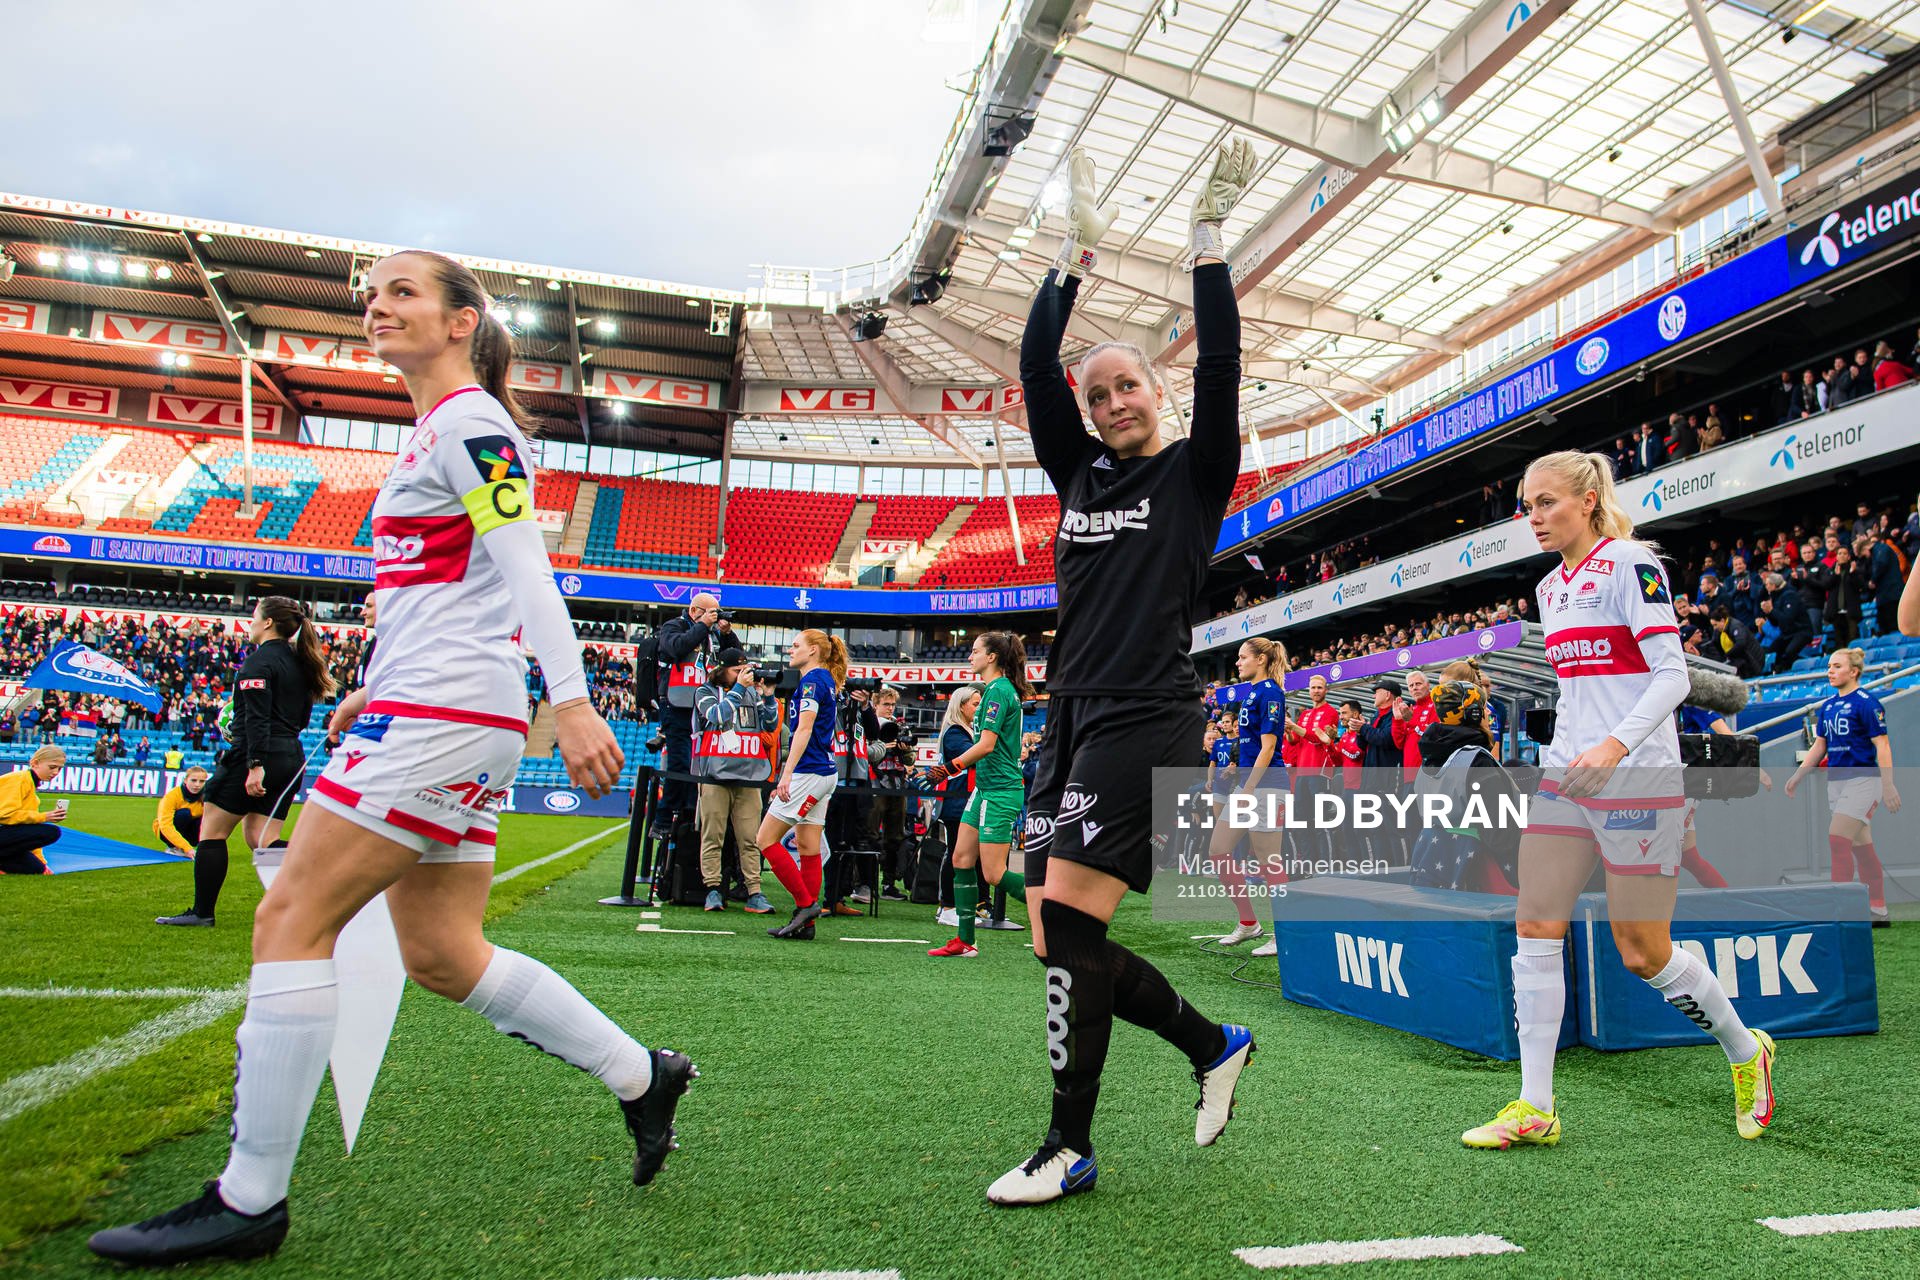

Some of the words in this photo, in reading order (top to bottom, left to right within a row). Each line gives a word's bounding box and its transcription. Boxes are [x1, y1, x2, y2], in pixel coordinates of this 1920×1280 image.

[107, 313, 224, 350] VG
[610, 374, 704, 404] VG
[782, 388, 870, 410] VG
[1497, 359, 1559, 419] FOTBALL
[161, 397, 271, 429] VG
[1796, 423, 1865, 461] telenor
[1662, 471, 1716, 501] telenor
[492, 483, 522, 519] C
[108, 539, 202, 566] SANDVIKEN
[205, 547, 310, 574] TOPPFOTBALL
[1472, 537, 1508, 560] telenor
[1401, 561, 1432, 582] telenor
[1342, 580, 1368, 599] telenor
[1291, 598, 1314, 615] telenor
[240, 680, 265, 690] VG
[873, 668, 921, 681] VG
[929, 667, 977, 681] VG
